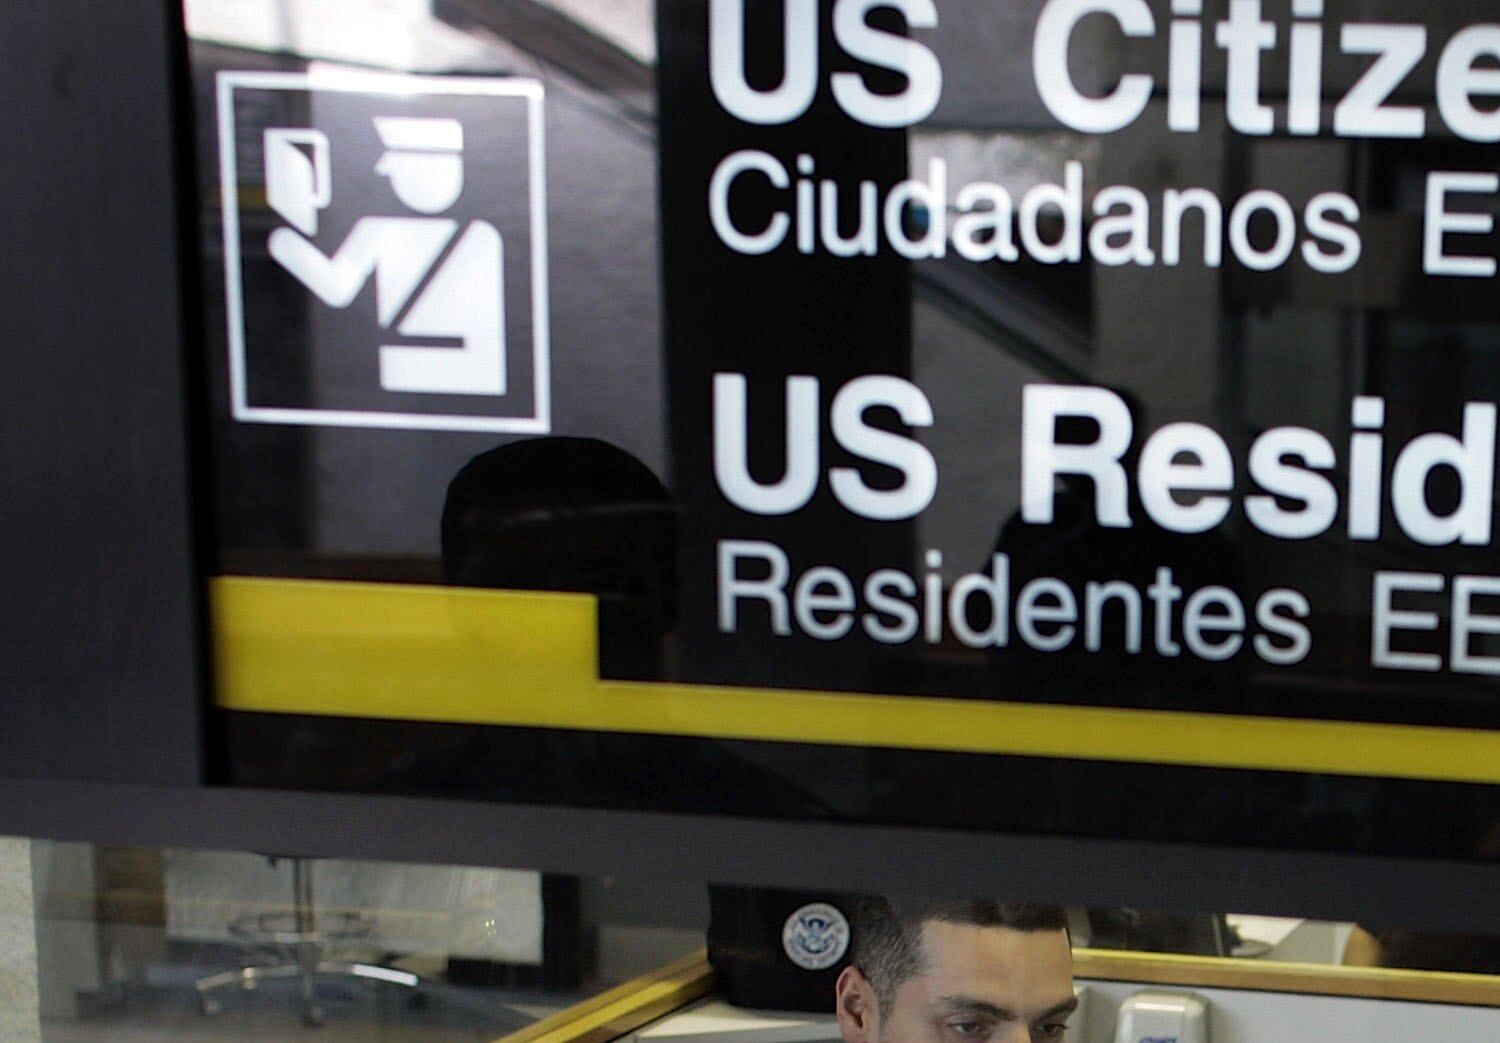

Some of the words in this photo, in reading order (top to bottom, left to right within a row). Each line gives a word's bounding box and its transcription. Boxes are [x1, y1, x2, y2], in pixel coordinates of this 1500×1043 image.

[709, 0, 943, 127] US
[709, 150, 1362, 273] Ciudadanos
[713, 372, 938, 520] US
[717, 540, 1310, 663] Residentes
